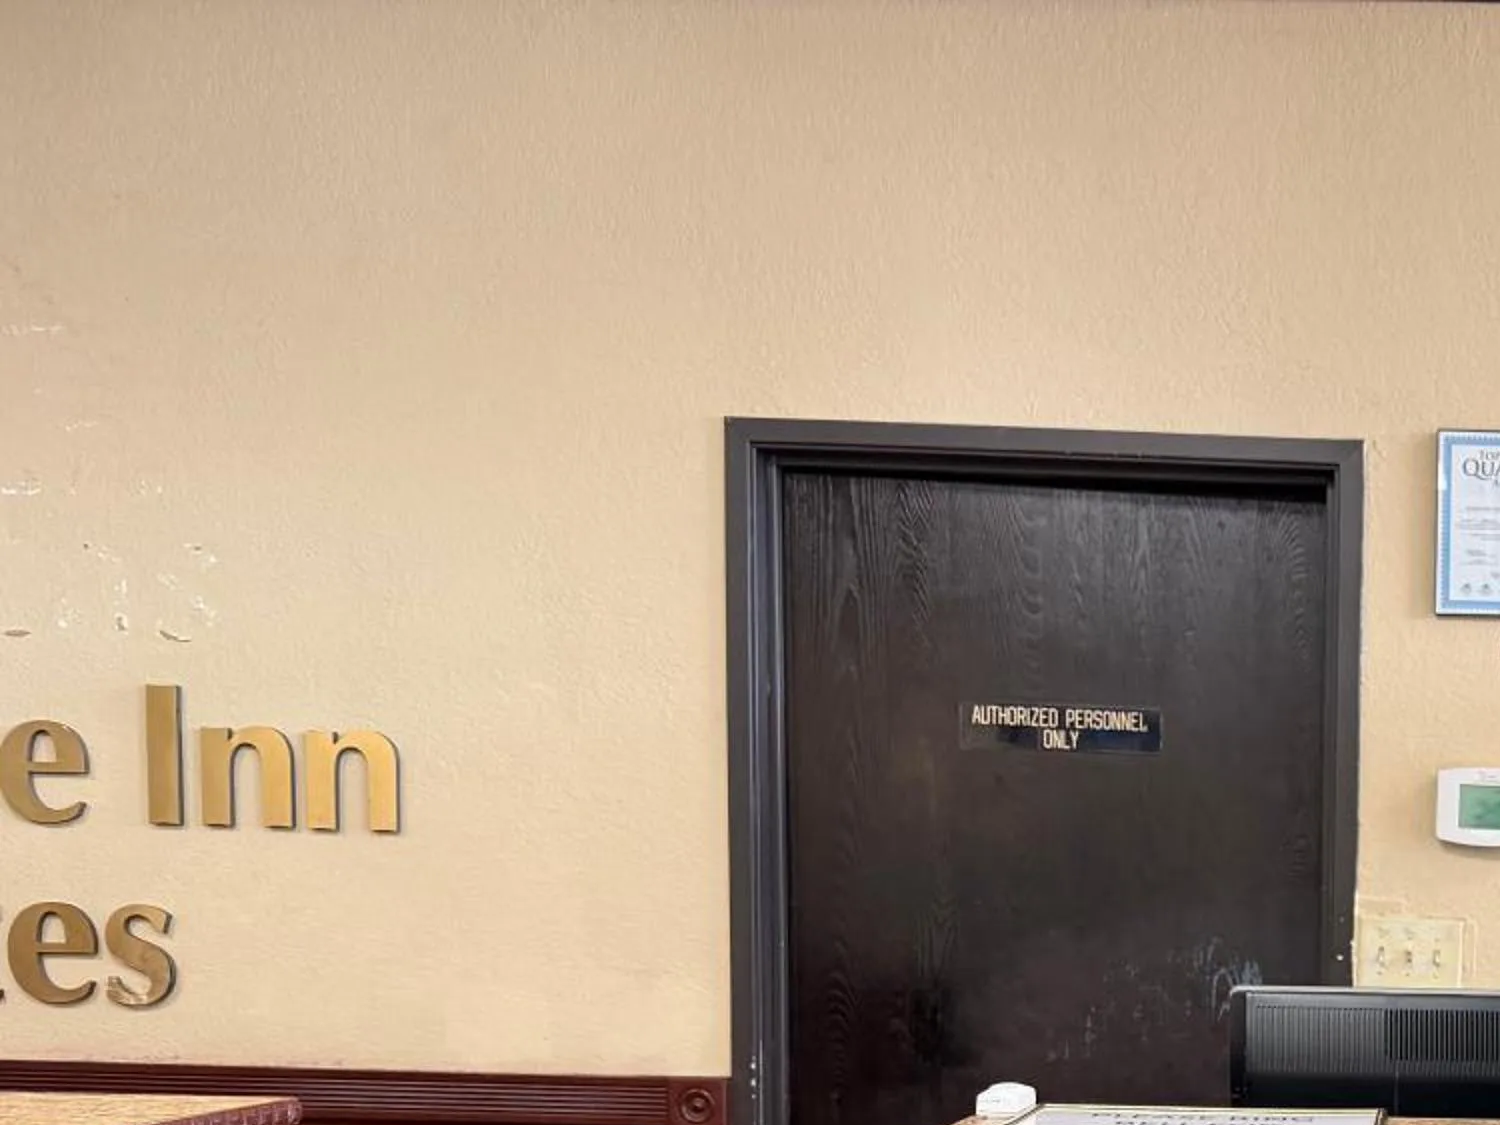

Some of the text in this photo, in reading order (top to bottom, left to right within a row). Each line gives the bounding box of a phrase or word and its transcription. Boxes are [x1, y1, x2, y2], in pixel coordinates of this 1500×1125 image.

[971, 705, 1149, 733] AUTHORIZED PERSONNEL
[1043, 729, 1080, 750] ONLY
[145, 684, 401, 833] Inn
[0, 901, 178, 1009] es
